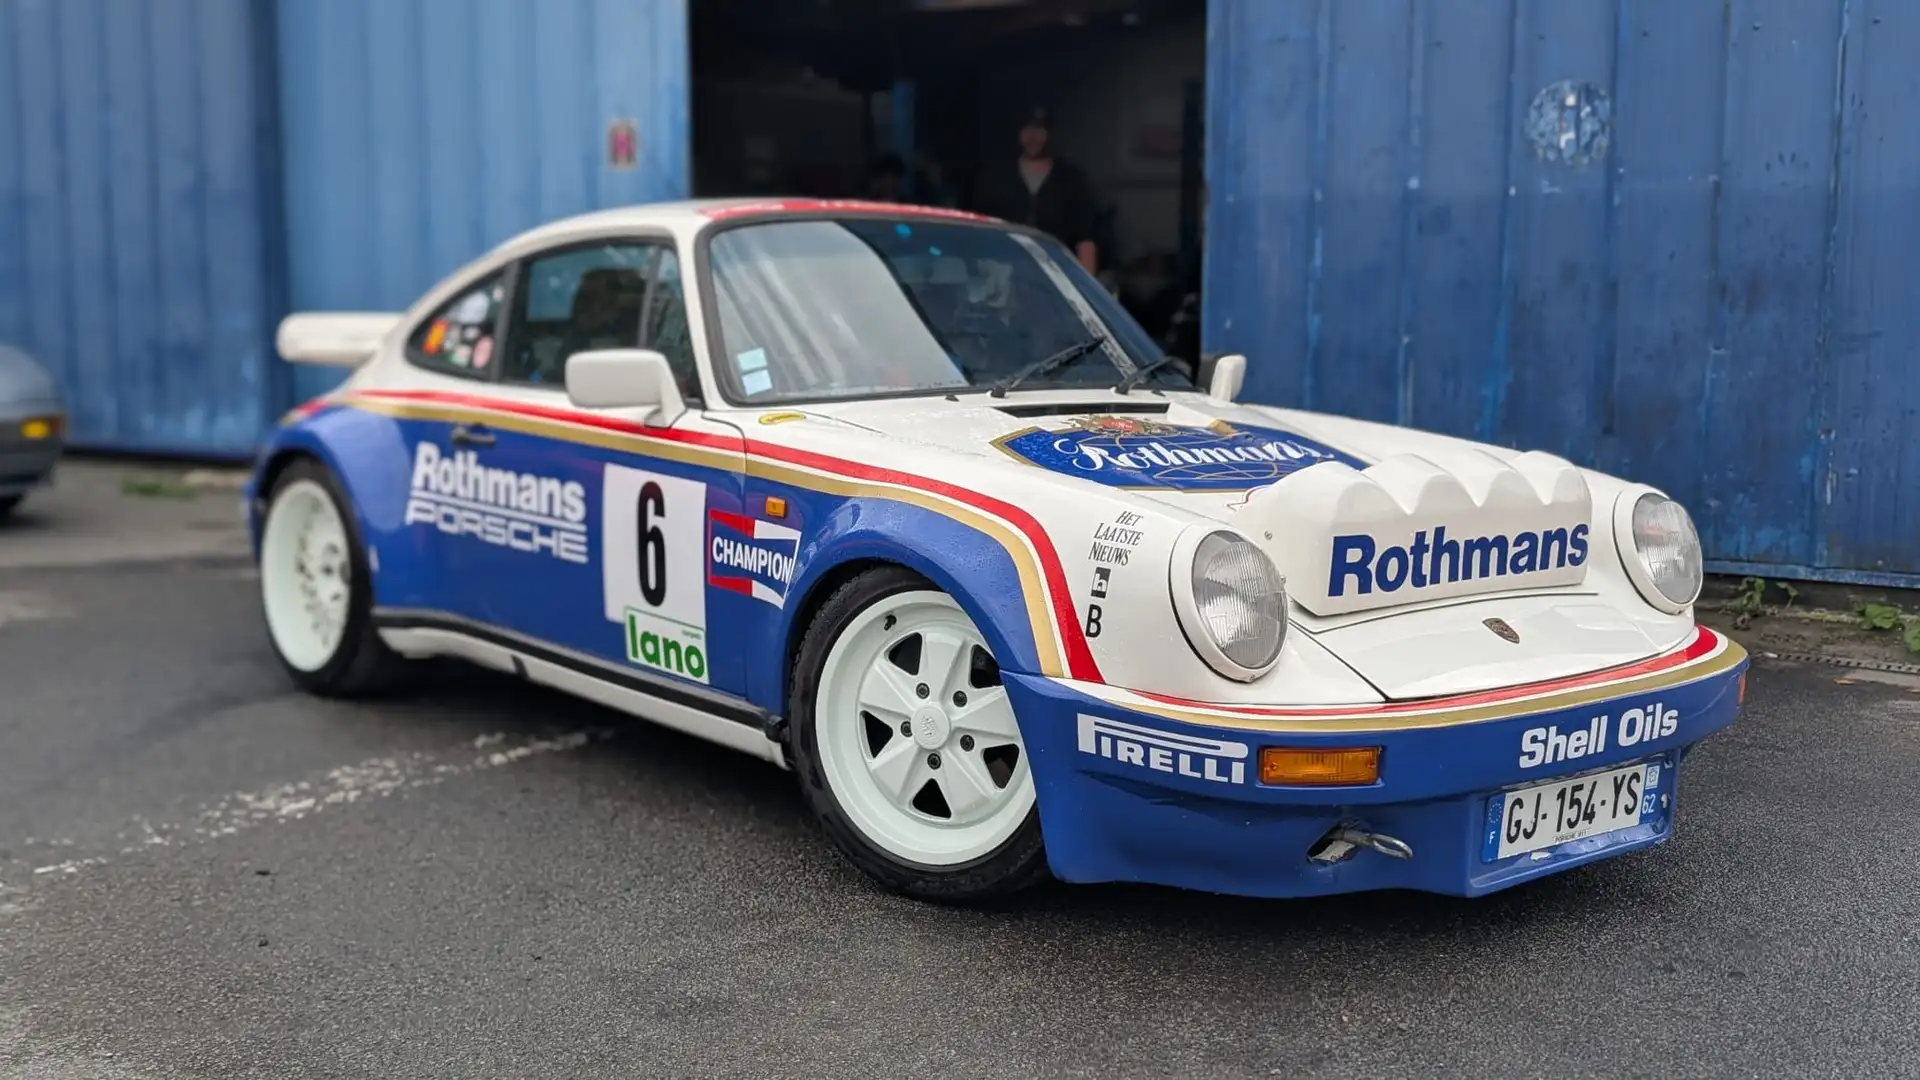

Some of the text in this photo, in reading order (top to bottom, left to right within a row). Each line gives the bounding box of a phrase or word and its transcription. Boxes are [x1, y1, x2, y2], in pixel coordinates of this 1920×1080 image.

[412, 440, 587, 522] Rothmans
[1053, 438, 1334, 471] Rothmans
[404, 499, 589, 564] PORSCHE
[637, 481, 667, 607] 6
[1093, 522, 1144, 546] LAATSTE
[1115, 510, 1144, 527] HET
[712, 536, 794, 584] CHAMPION
[1088, 541, 1132, 566] NIEUWS
[1328, 525, 1589, 597] Rothmans
[629, 613, 705, 678] lano
[1085, 603, 1102, 638] B
[1077, 713, 1248, 784] PIRELLI
[1519, 702, 1678, 768] Shell Oils
[1506, 772, 1641, 844] GJ-154-YS
[1642, 793, 1656, 814] 62
[1489, 831, 1496, 844] F
